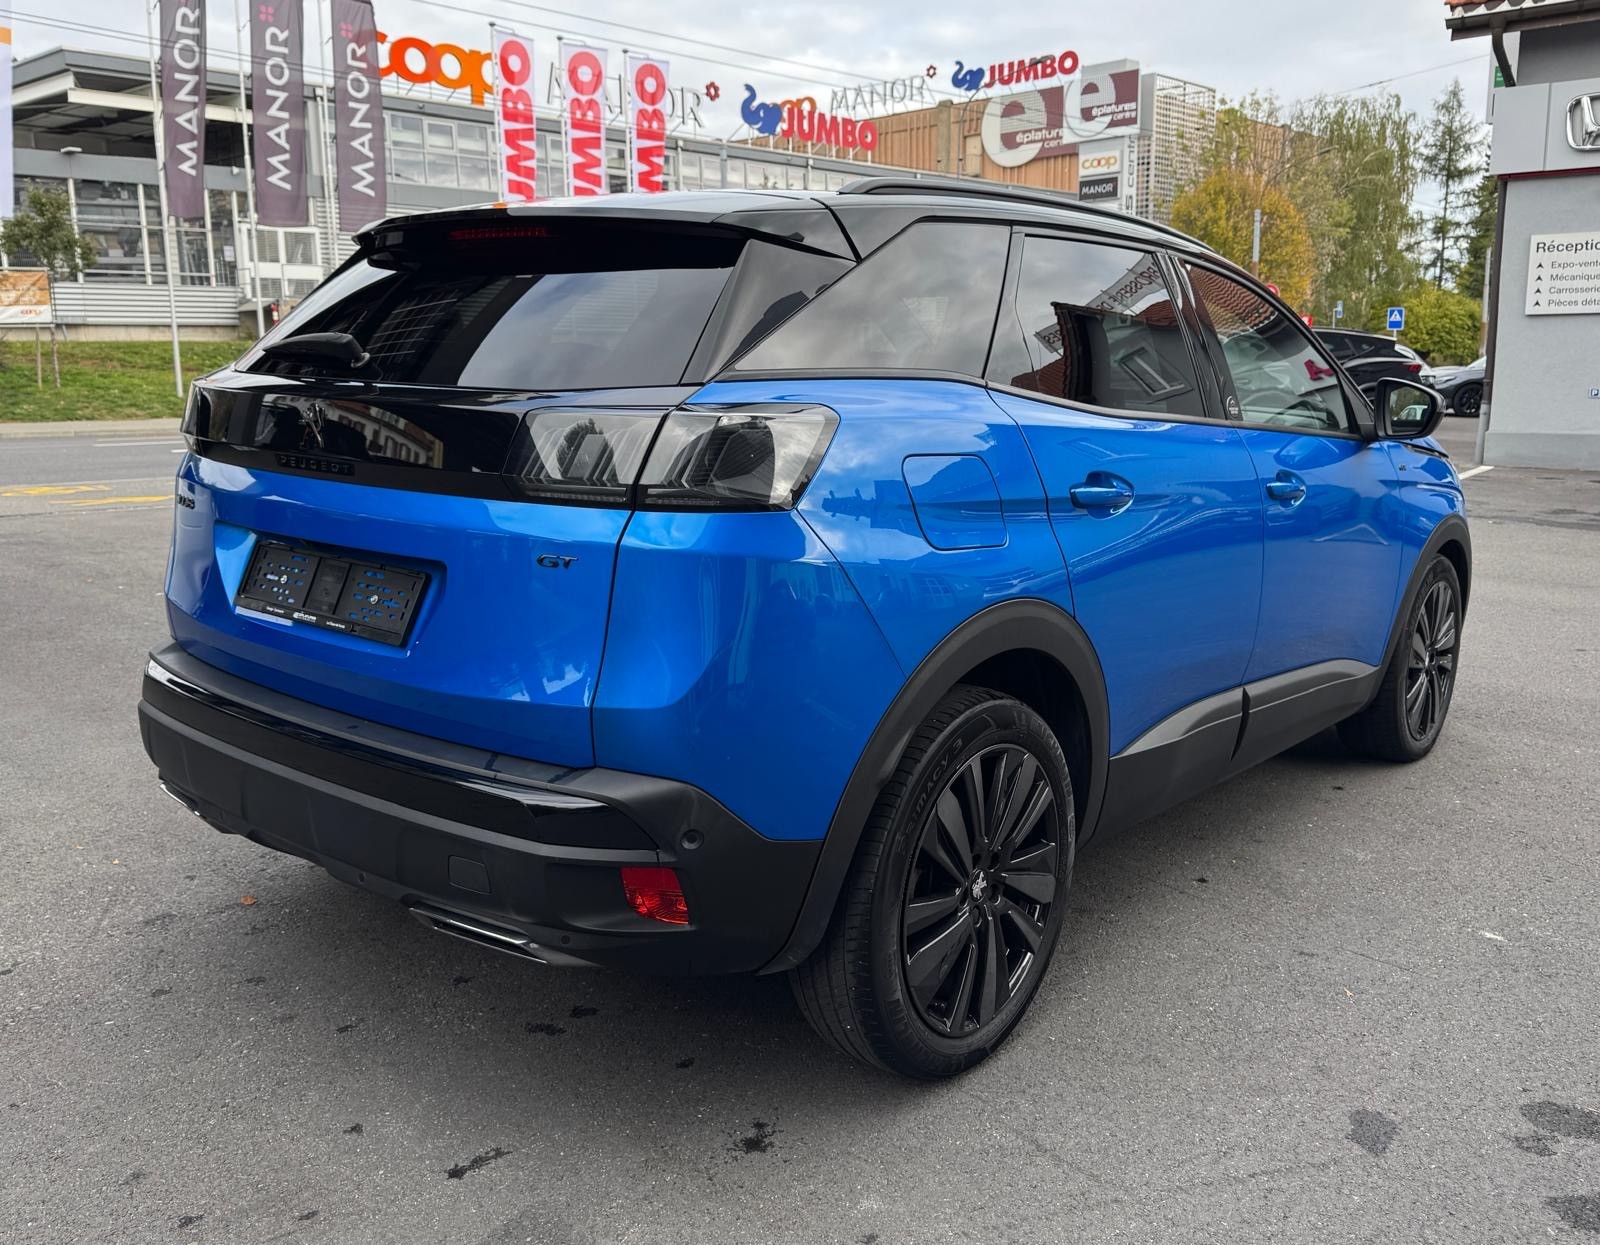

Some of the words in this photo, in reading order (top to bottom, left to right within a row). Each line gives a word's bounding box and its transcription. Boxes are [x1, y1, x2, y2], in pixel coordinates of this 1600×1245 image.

[984, 50, 1079, 88] JUMBO
[173, 6, 200, 177] MANOR
[265, 26, 292, 191] MANOR
[831, 75, 935, 114] MANOR
[346, 42, 375, 197] MANOR
[782, 104, 878, 151] JUMBO
[1082, 156, 1117, 170] coop
[1082, 183, 1113, 196] MANOR
[280, 456, 350, 474] PEUGEOT
[537, 554, 579, 569] GT
